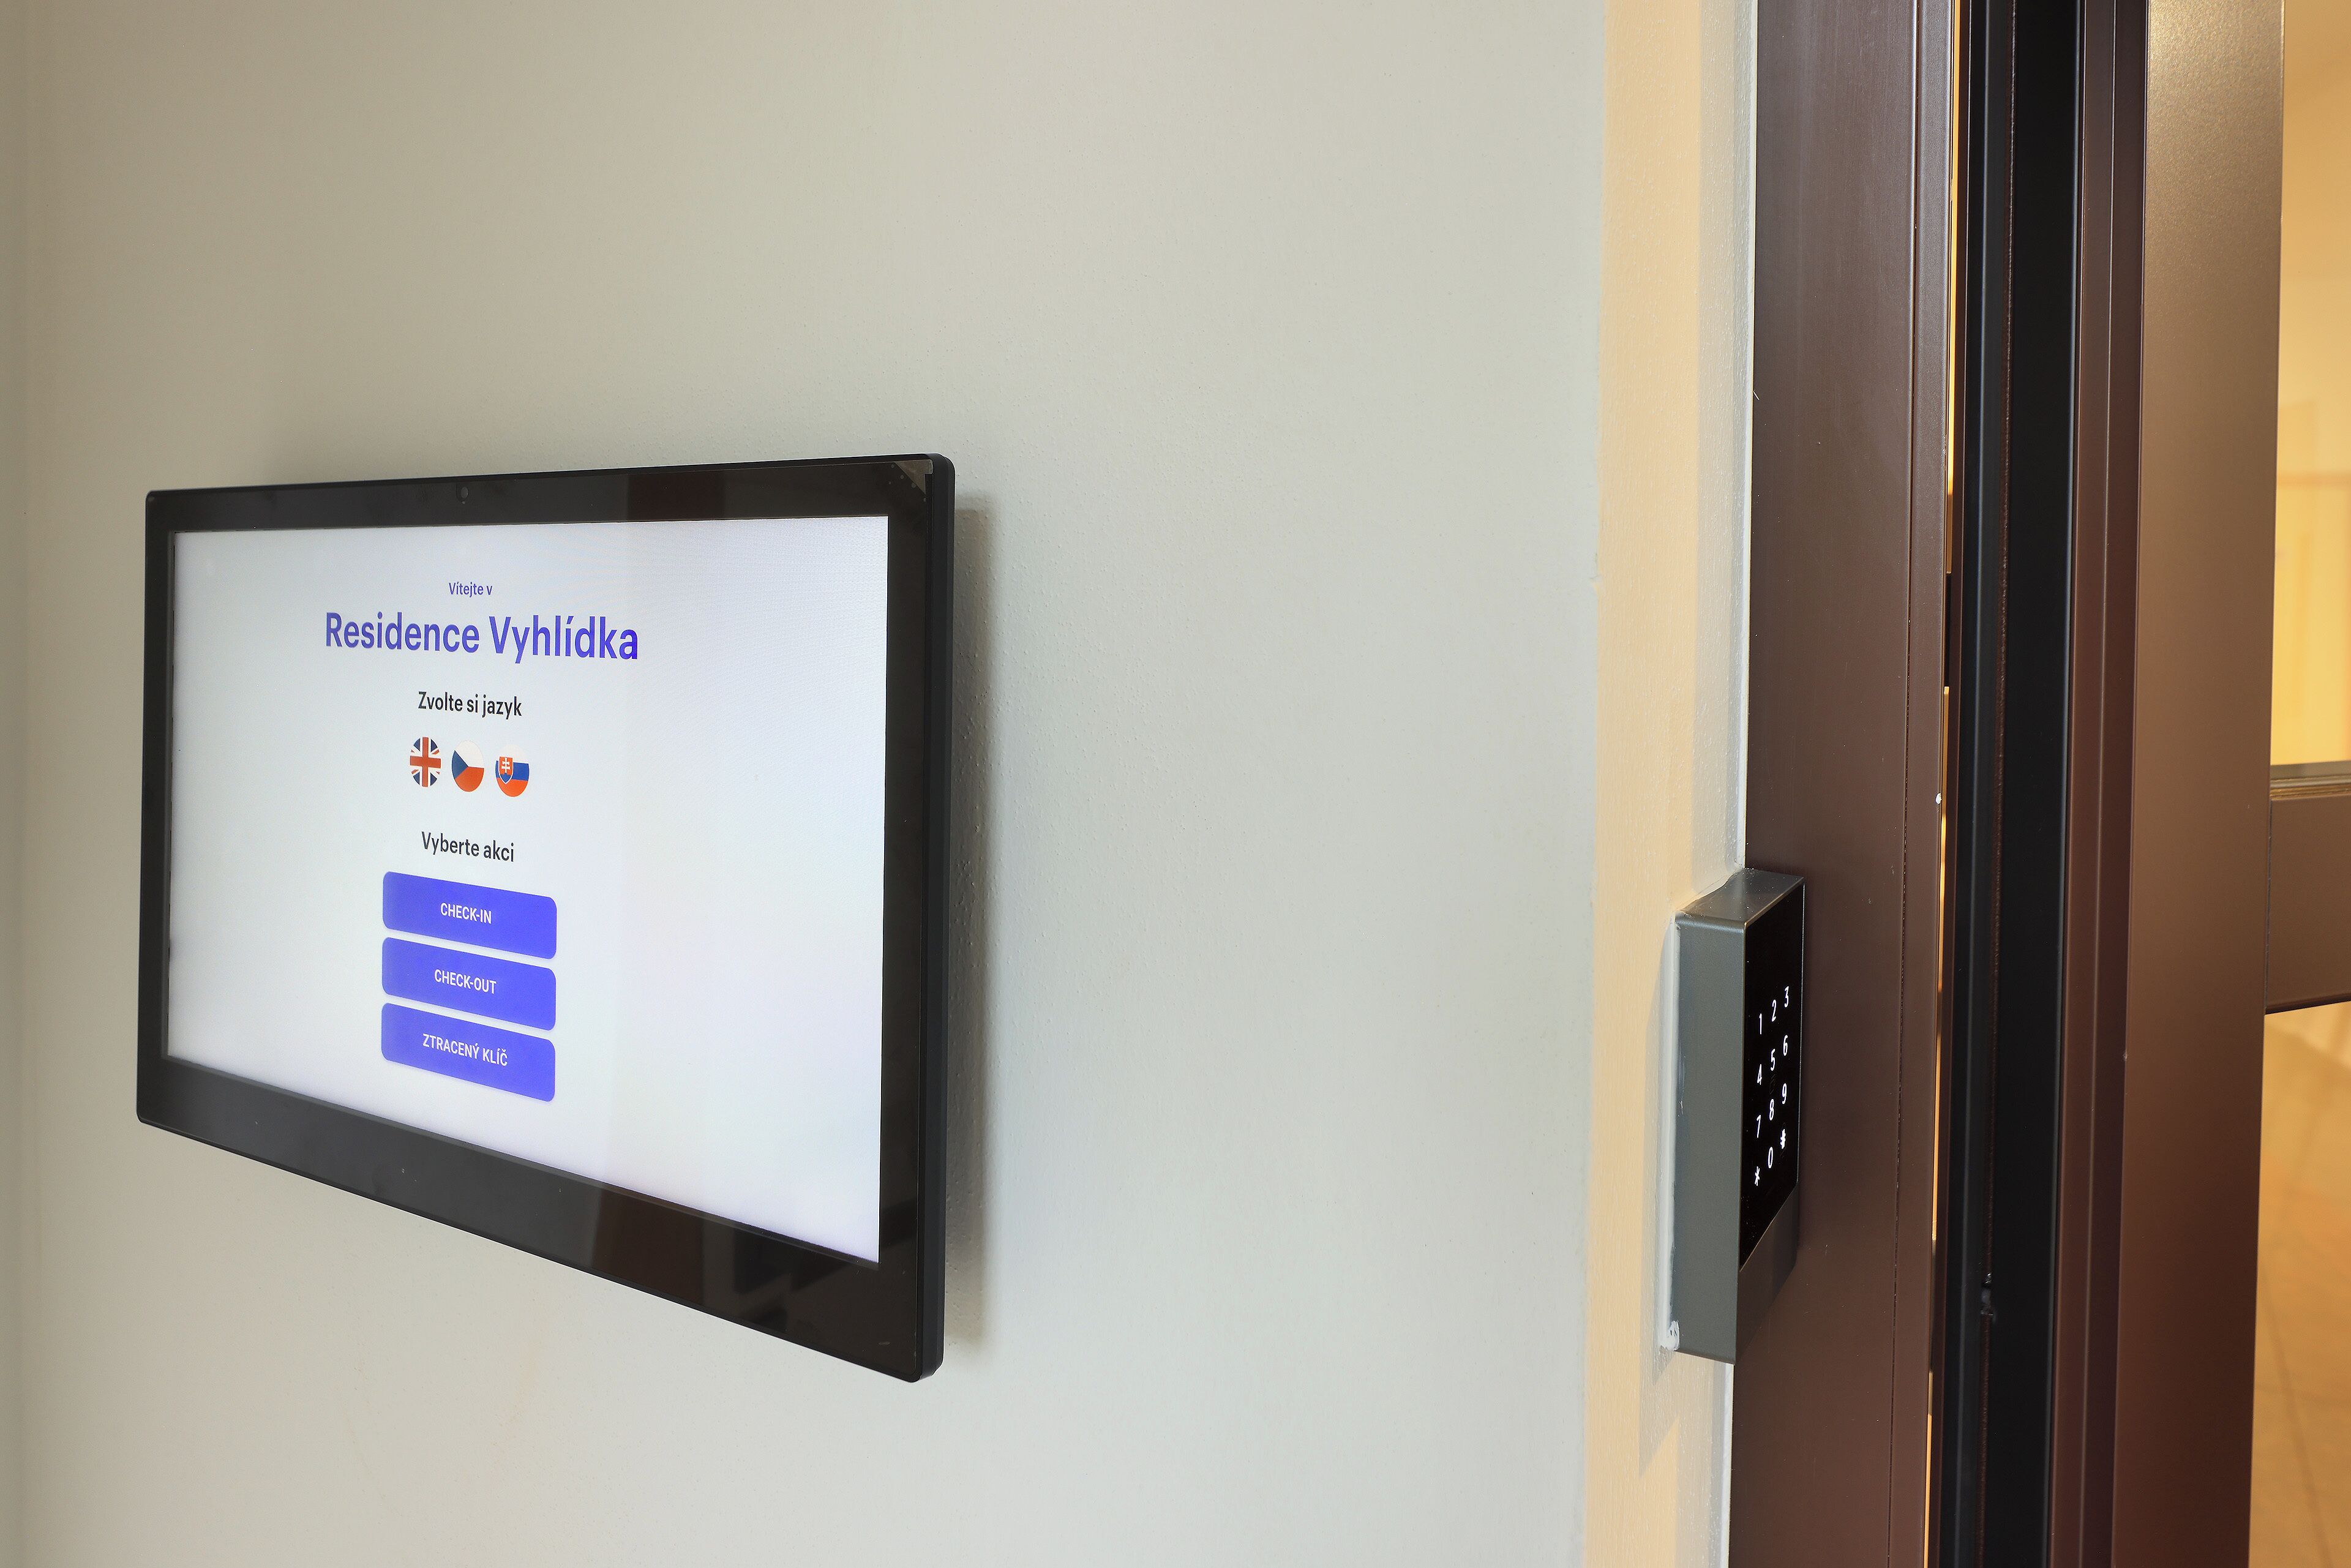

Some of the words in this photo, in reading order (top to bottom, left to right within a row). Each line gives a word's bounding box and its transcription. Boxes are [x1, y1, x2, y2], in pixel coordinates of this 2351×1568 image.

[448, 582, 484, 598] Vítejte
[486, 585, 493, 596] v
[326, 611, 480, 653] Residence
[489, 615, 638, 664] Vyhlídka
[418, 691, 463, 712] Zvolte
[467, 693, 478, 713] si
[482, 694, 522, 720] jazyk
[421, 831, 479, 857] Vyberte
[483, 839, 514, 862] akci
[440, 902, 492, 925] CHECK-IN
[434, 969, 497, 994] CHECK-OUT
[1758, 1013, 1763, 1035] 1
[1771, 999, 1777, 1022] 2
[1784, 986, 1790, 1008] 3
[422, 1032, 480, 1060] ZTRACENÝ
[482, 1047, 508, 1067] KLÍČ
[1757, 1063, 1763, 1086] 4
[1770, 1048, 1775, 1071] 5
[1783, 1035, 1788, 1056] 6
[1756, 1114, 1761, 1138] 7
[1769, 1098, 1774, 1121] 8
[1782, 1082, 1787, 1105] 9
[1768, 1146, 1774, 1169] 0
